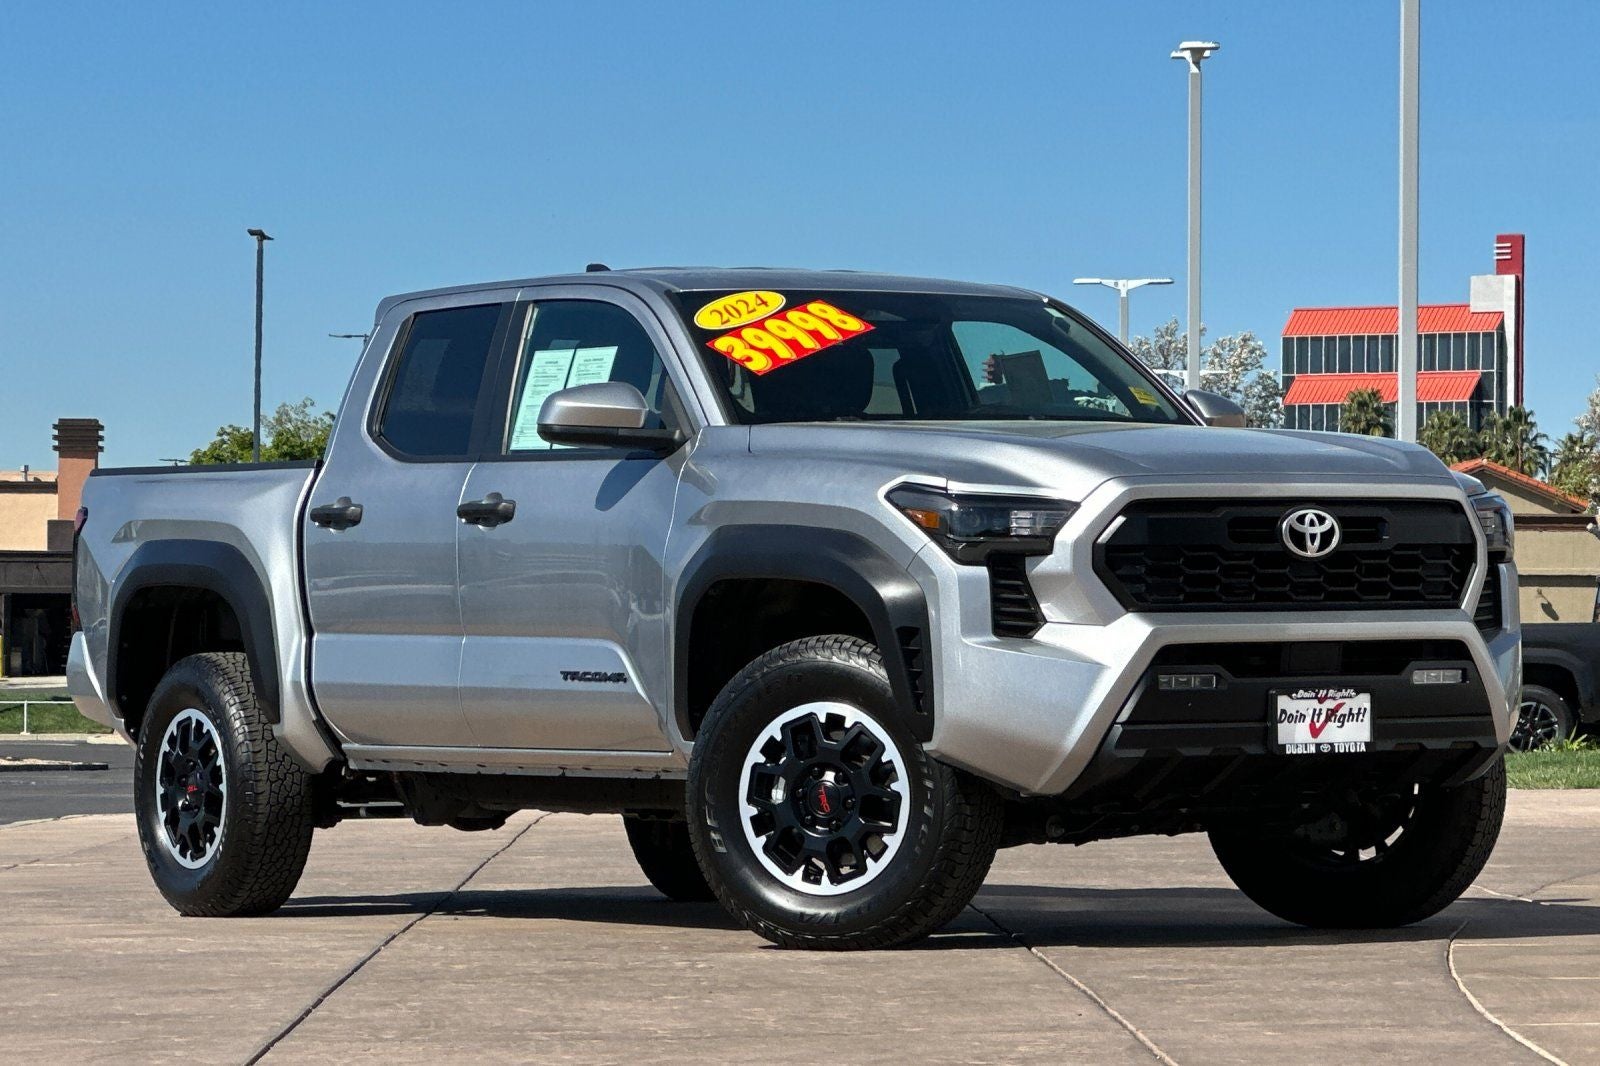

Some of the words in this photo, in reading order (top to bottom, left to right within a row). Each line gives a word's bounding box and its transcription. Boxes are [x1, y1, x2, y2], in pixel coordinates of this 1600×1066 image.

[709, 293, 769, 325] 2024
[713, 302, 866, 371] 39998
[560, 670, 627, 683] TACOMA
[1277, 708, 1309, 724] Doin'
[1311, 707, 1322, 723] It
[1326, 707, 1367, 728] Right!
[1285, 743, 1316, 754] DUBLIN
[1333, 742, 1366, 753] TOYOTA
